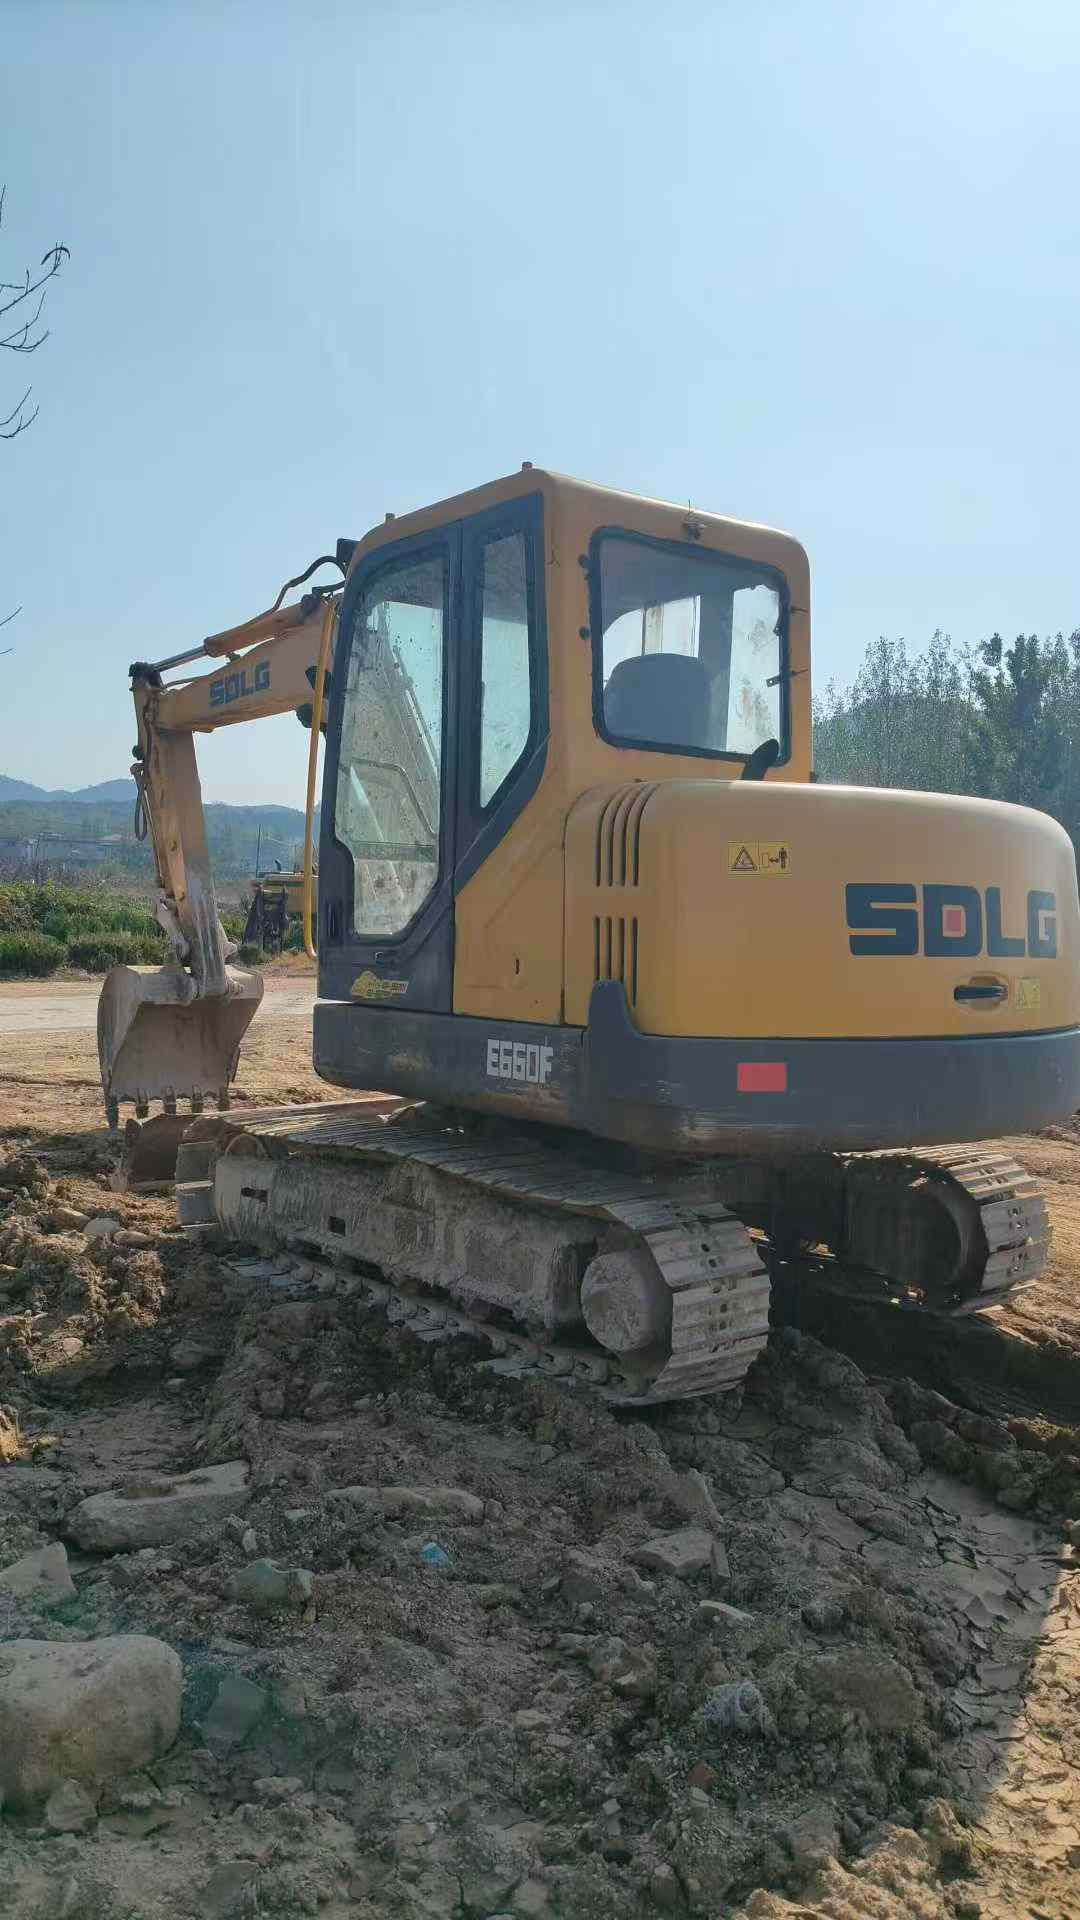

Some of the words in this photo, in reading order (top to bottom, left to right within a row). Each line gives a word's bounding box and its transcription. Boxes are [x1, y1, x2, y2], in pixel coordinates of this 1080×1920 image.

[210, 661, 270, 704] SDLG
[845, 883, 1057, 959] SDLG
[487, 1038, 554, 1083] E660F
